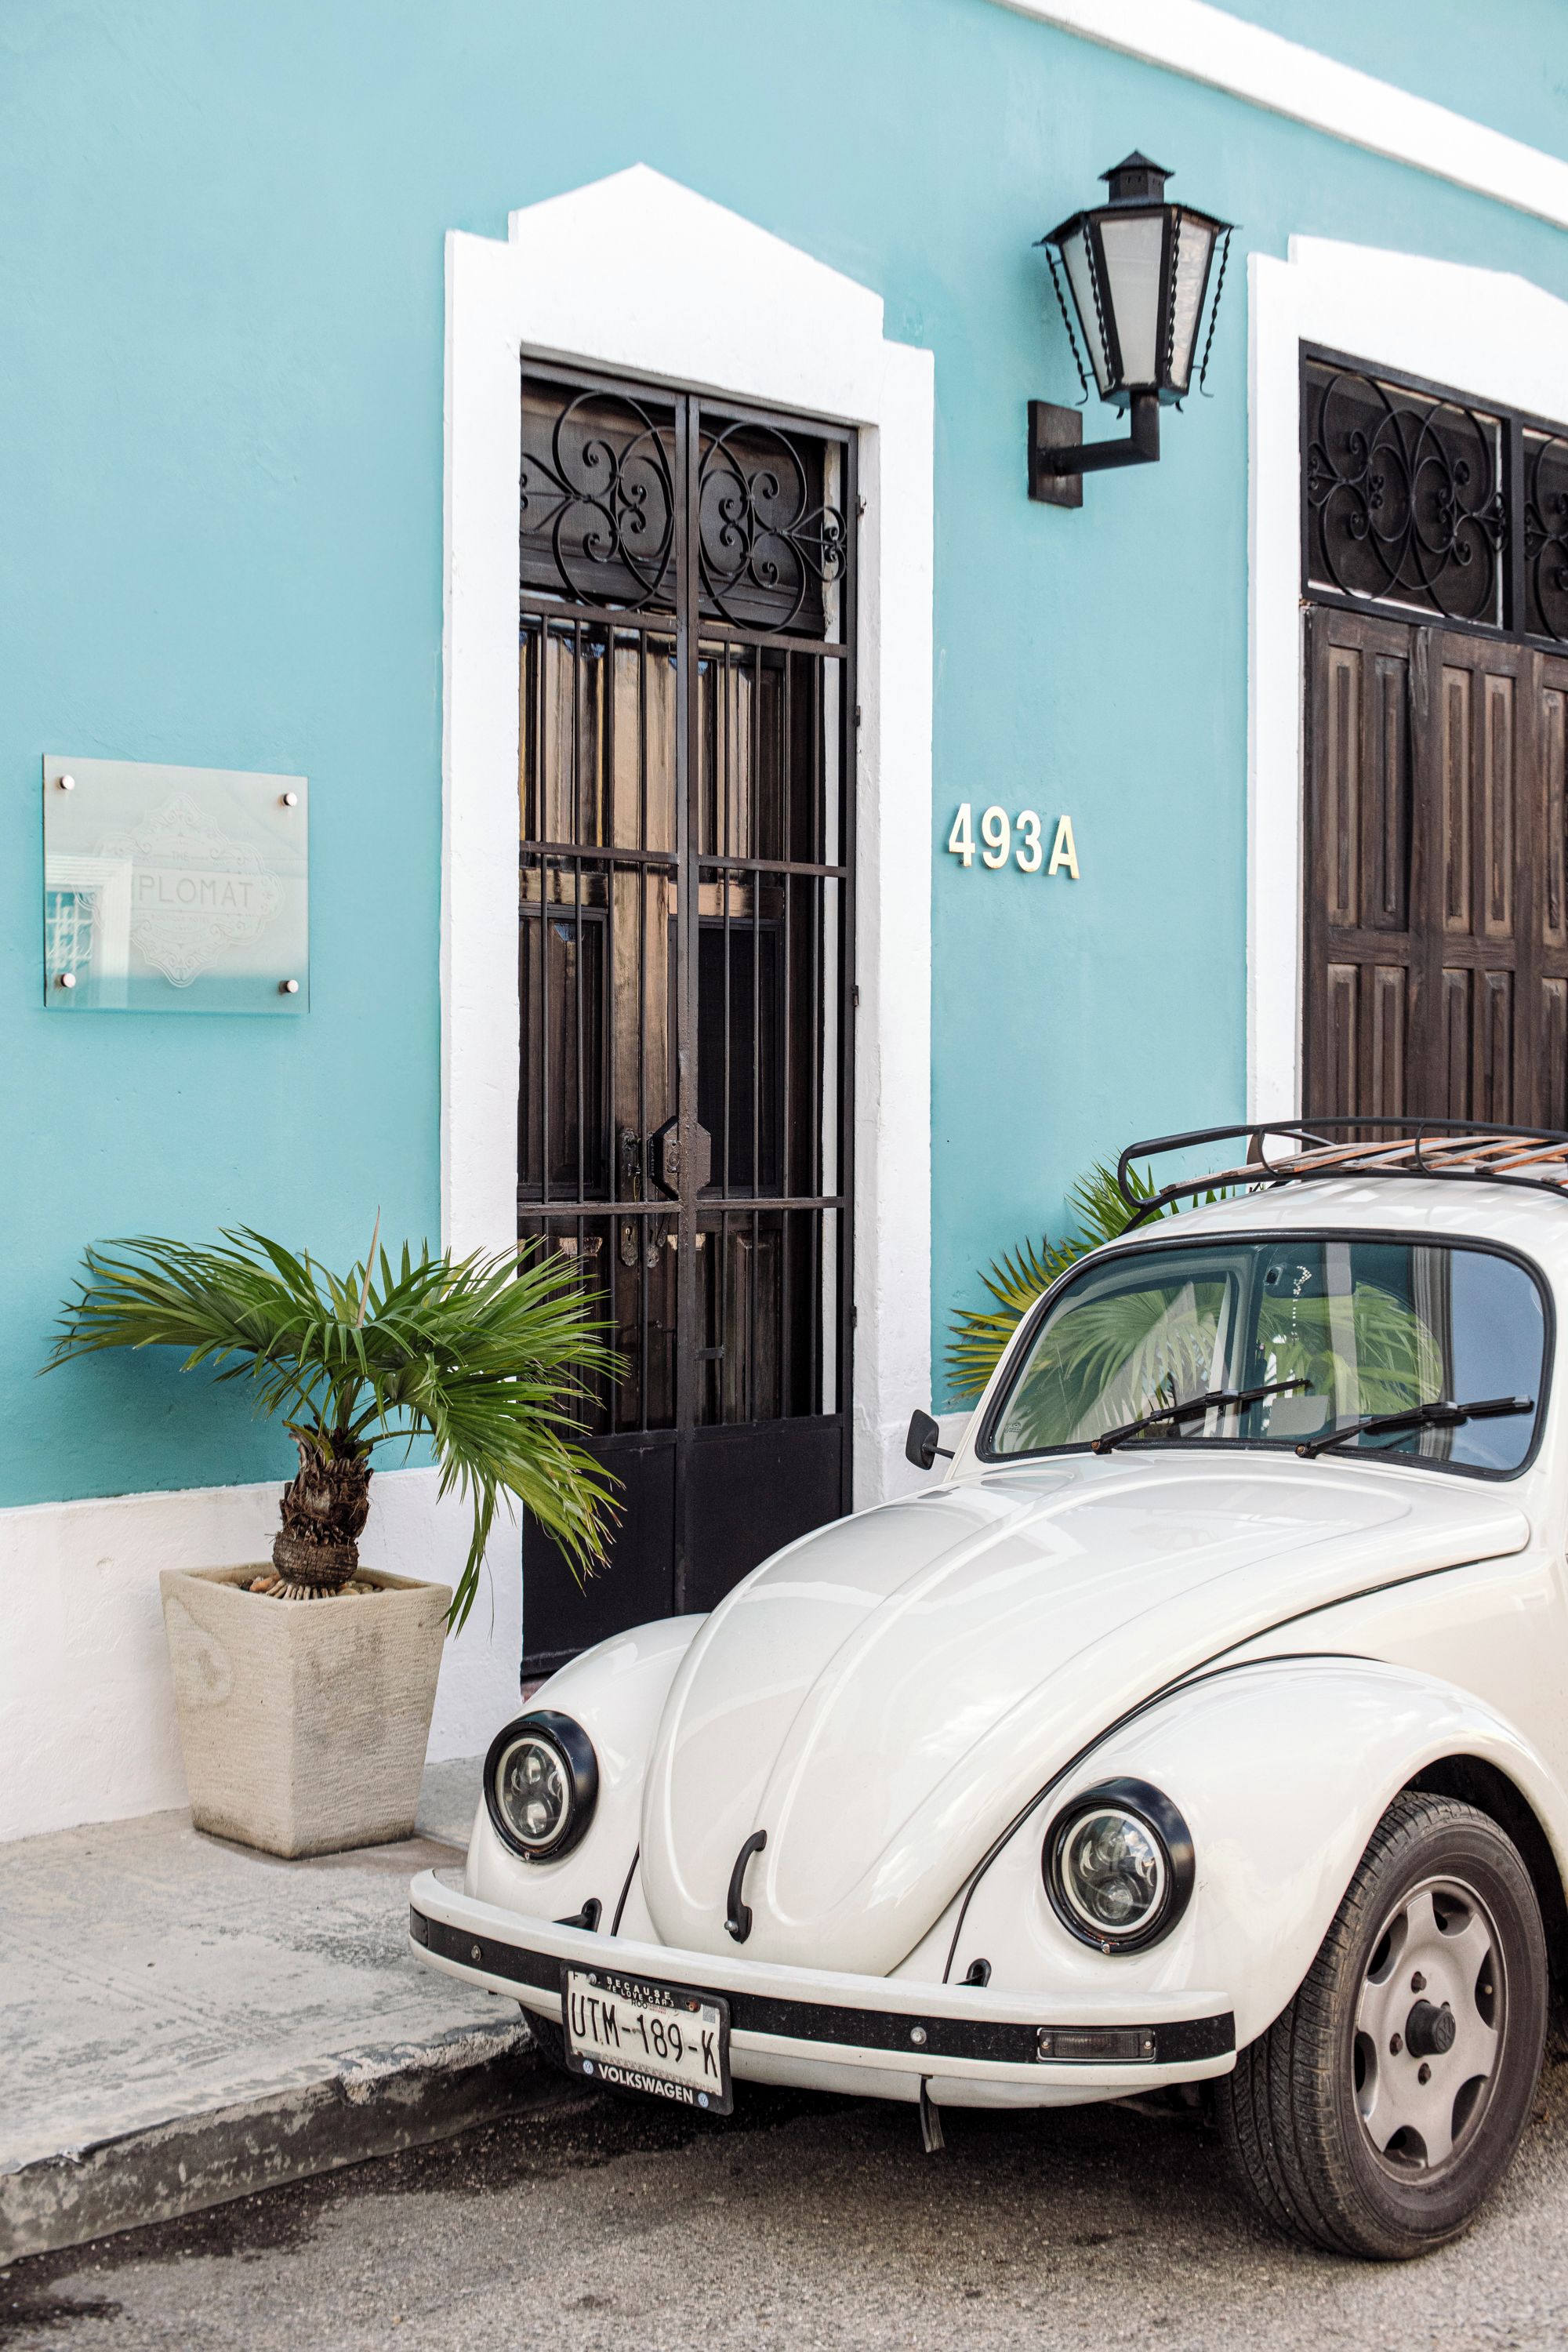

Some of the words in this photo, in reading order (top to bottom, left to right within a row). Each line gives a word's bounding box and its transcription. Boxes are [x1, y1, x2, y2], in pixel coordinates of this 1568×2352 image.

[949, 803, 1080, 879] 493A
[138, 875, 254, 907] PLOMAT
[607, 1976, 671, 1999] BECAUSE
[621, 1988, 643, 2001] LOVE
[571, 1992, 719, 2078] UTM-189-K
[597, 2063, 694, 2104] VOLKSWAGEN
